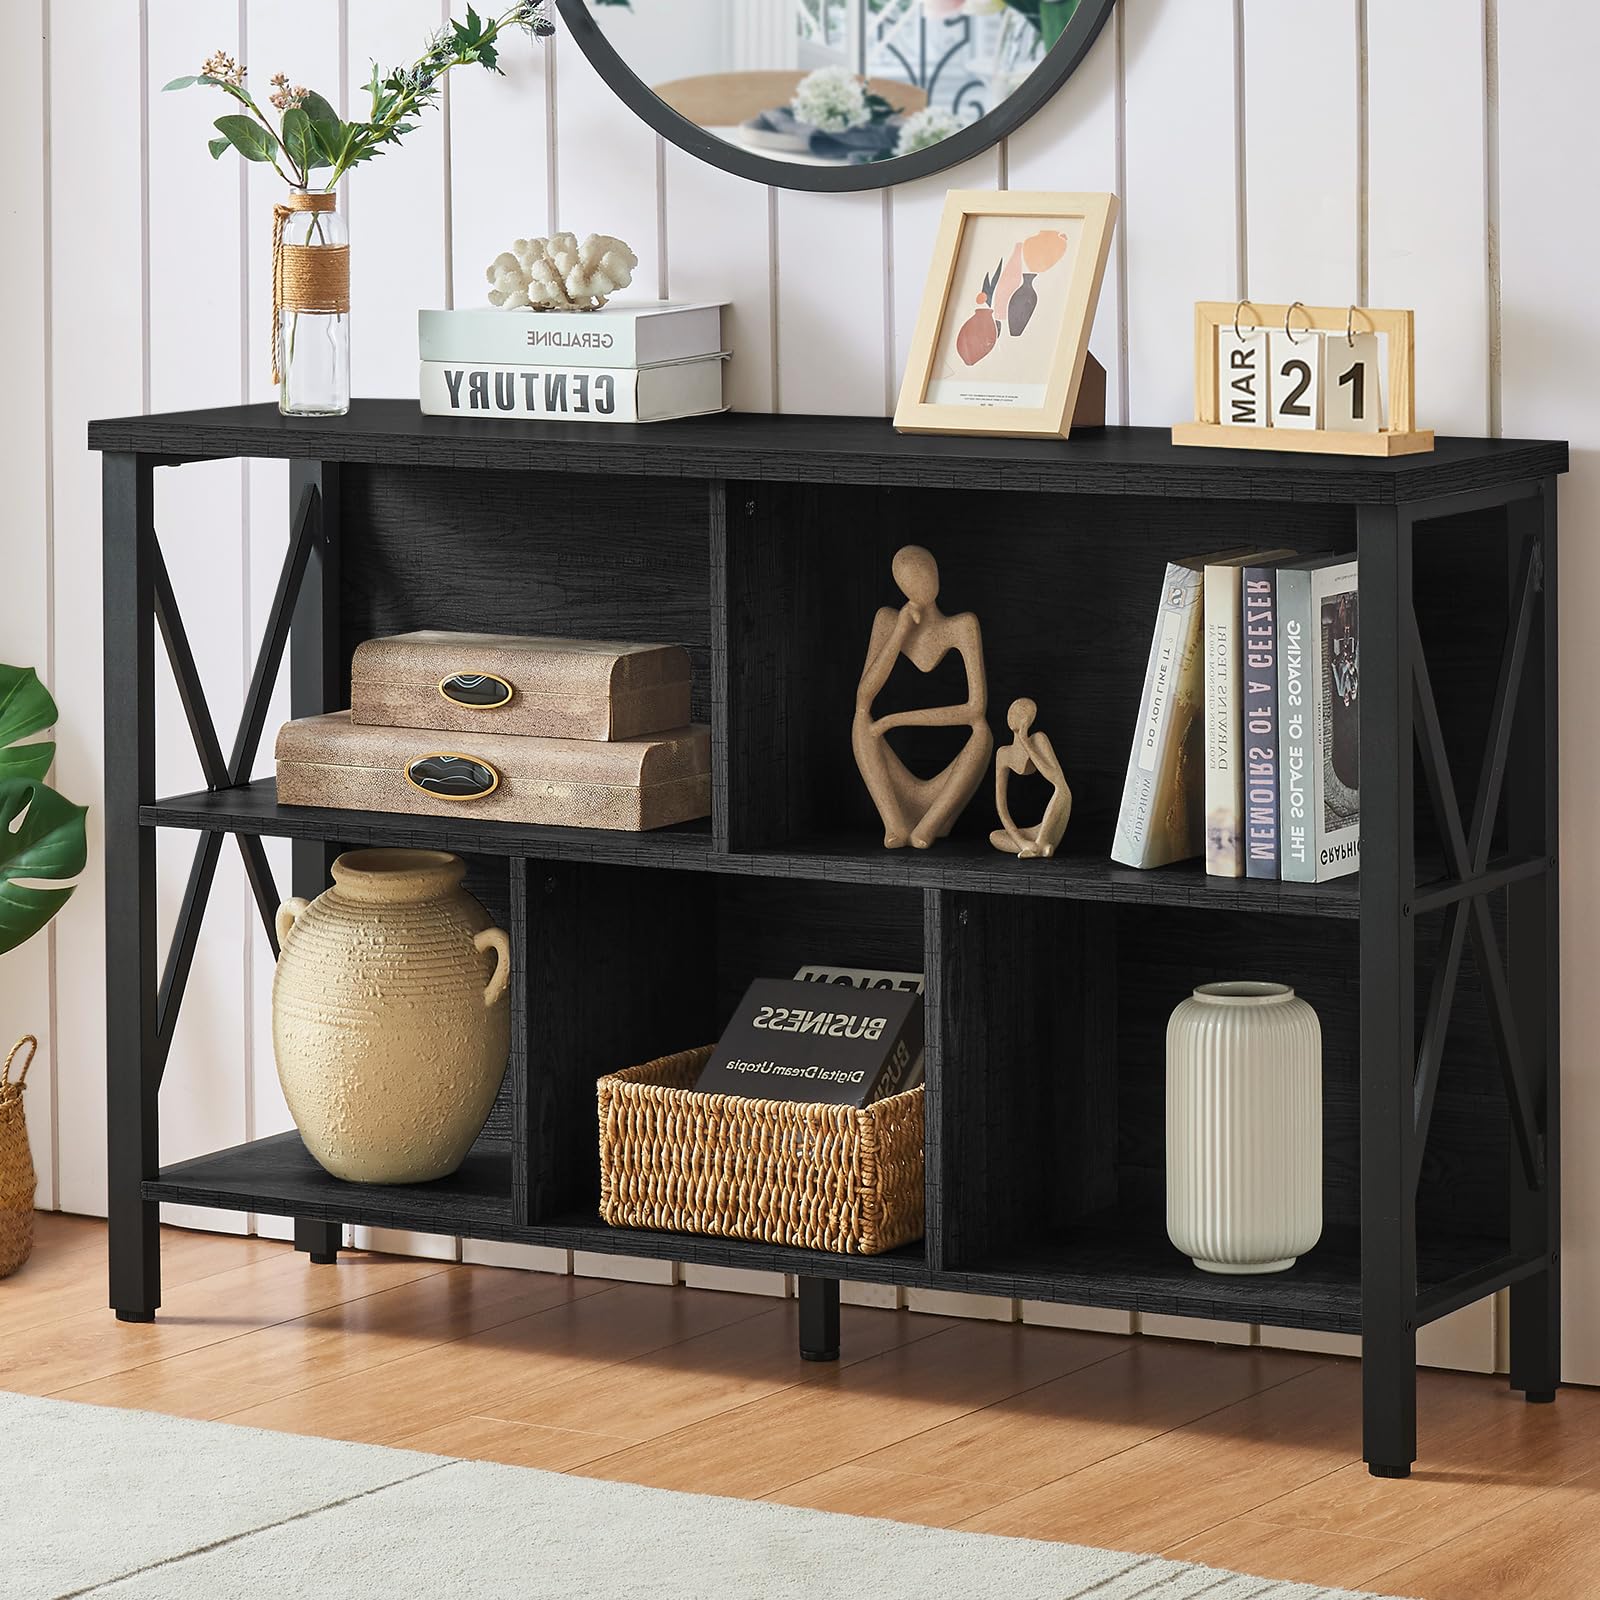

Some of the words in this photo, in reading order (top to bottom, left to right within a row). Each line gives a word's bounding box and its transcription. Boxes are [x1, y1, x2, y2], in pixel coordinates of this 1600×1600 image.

[1231, 348, 1256, 423] MAR
[1279, 359, 1312, 417] 2
[1338, 362, 1365, 419] 1
